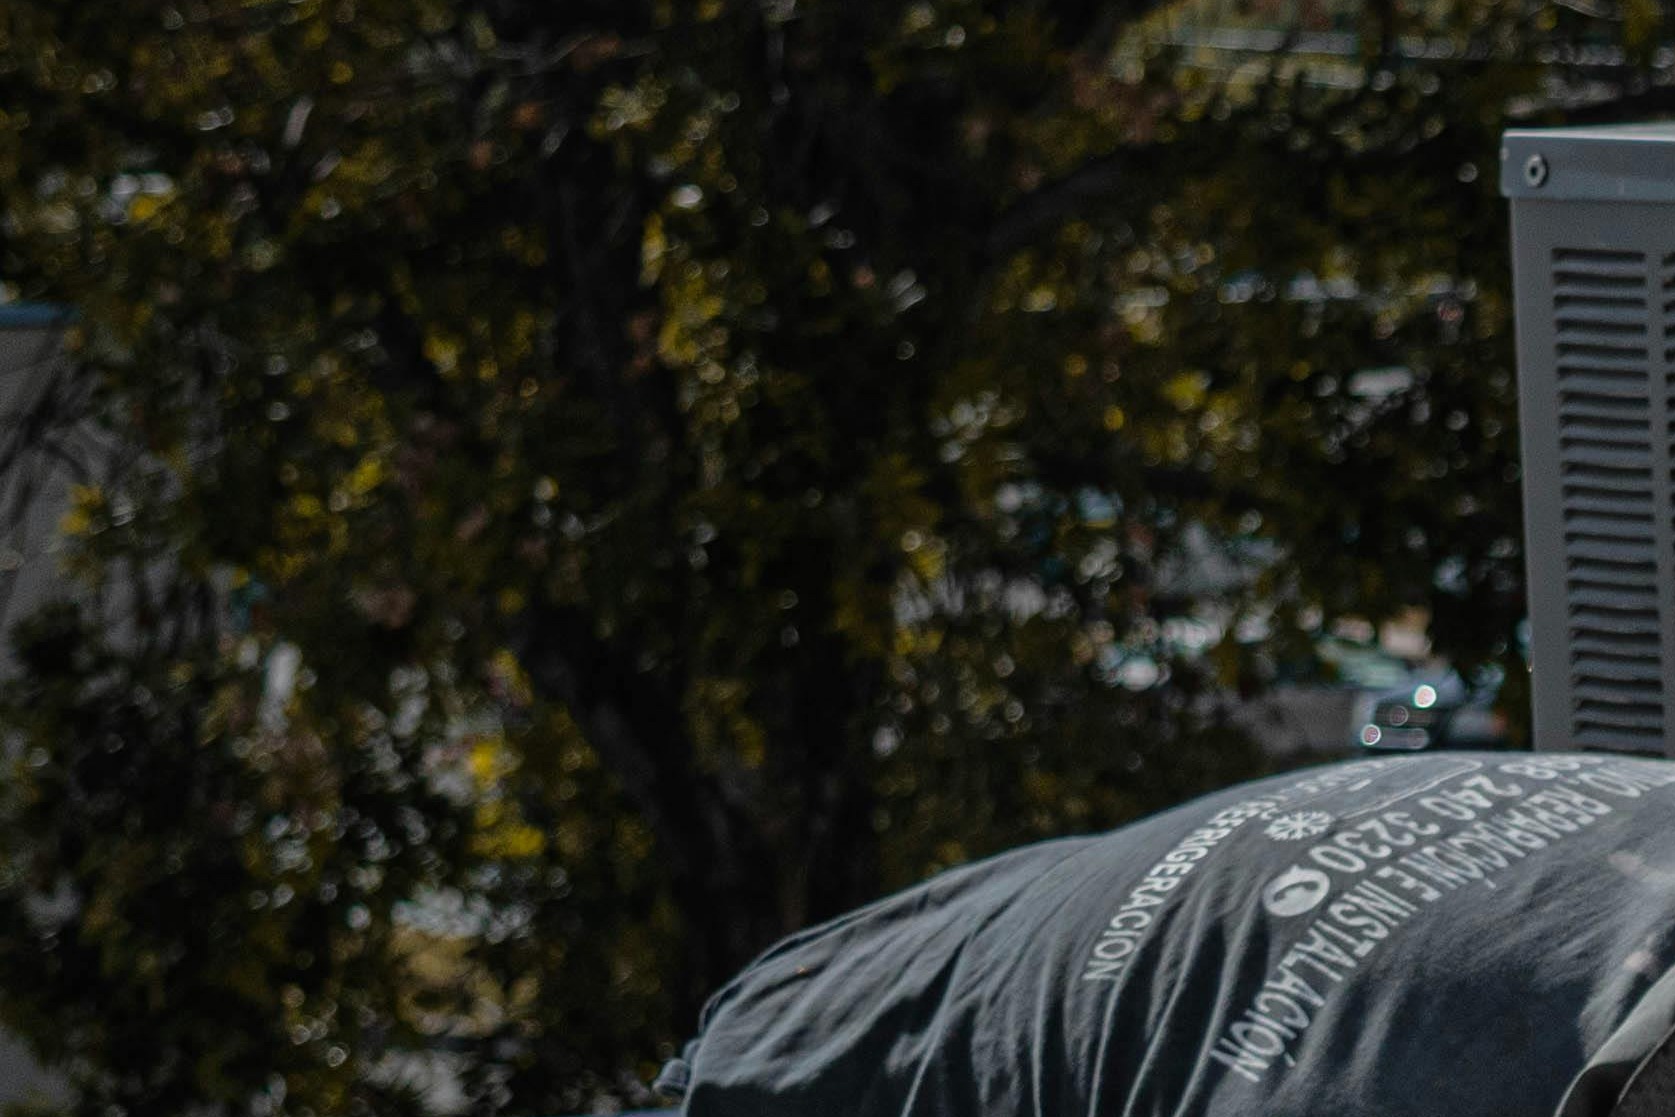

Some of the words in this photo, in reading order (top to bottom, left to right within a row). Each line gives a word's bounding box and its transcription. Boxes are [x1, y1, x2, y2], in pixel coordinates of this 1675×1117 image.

[1419, 774, 1523, 820] 240
[1308, 812, 1440, 873] 3230
[1400, 784, 1612, 889] REPARACIÓN
[1375, 866, 1442, 901] E
[1209, 880, 1420, 1083] INSTALACIÓN
